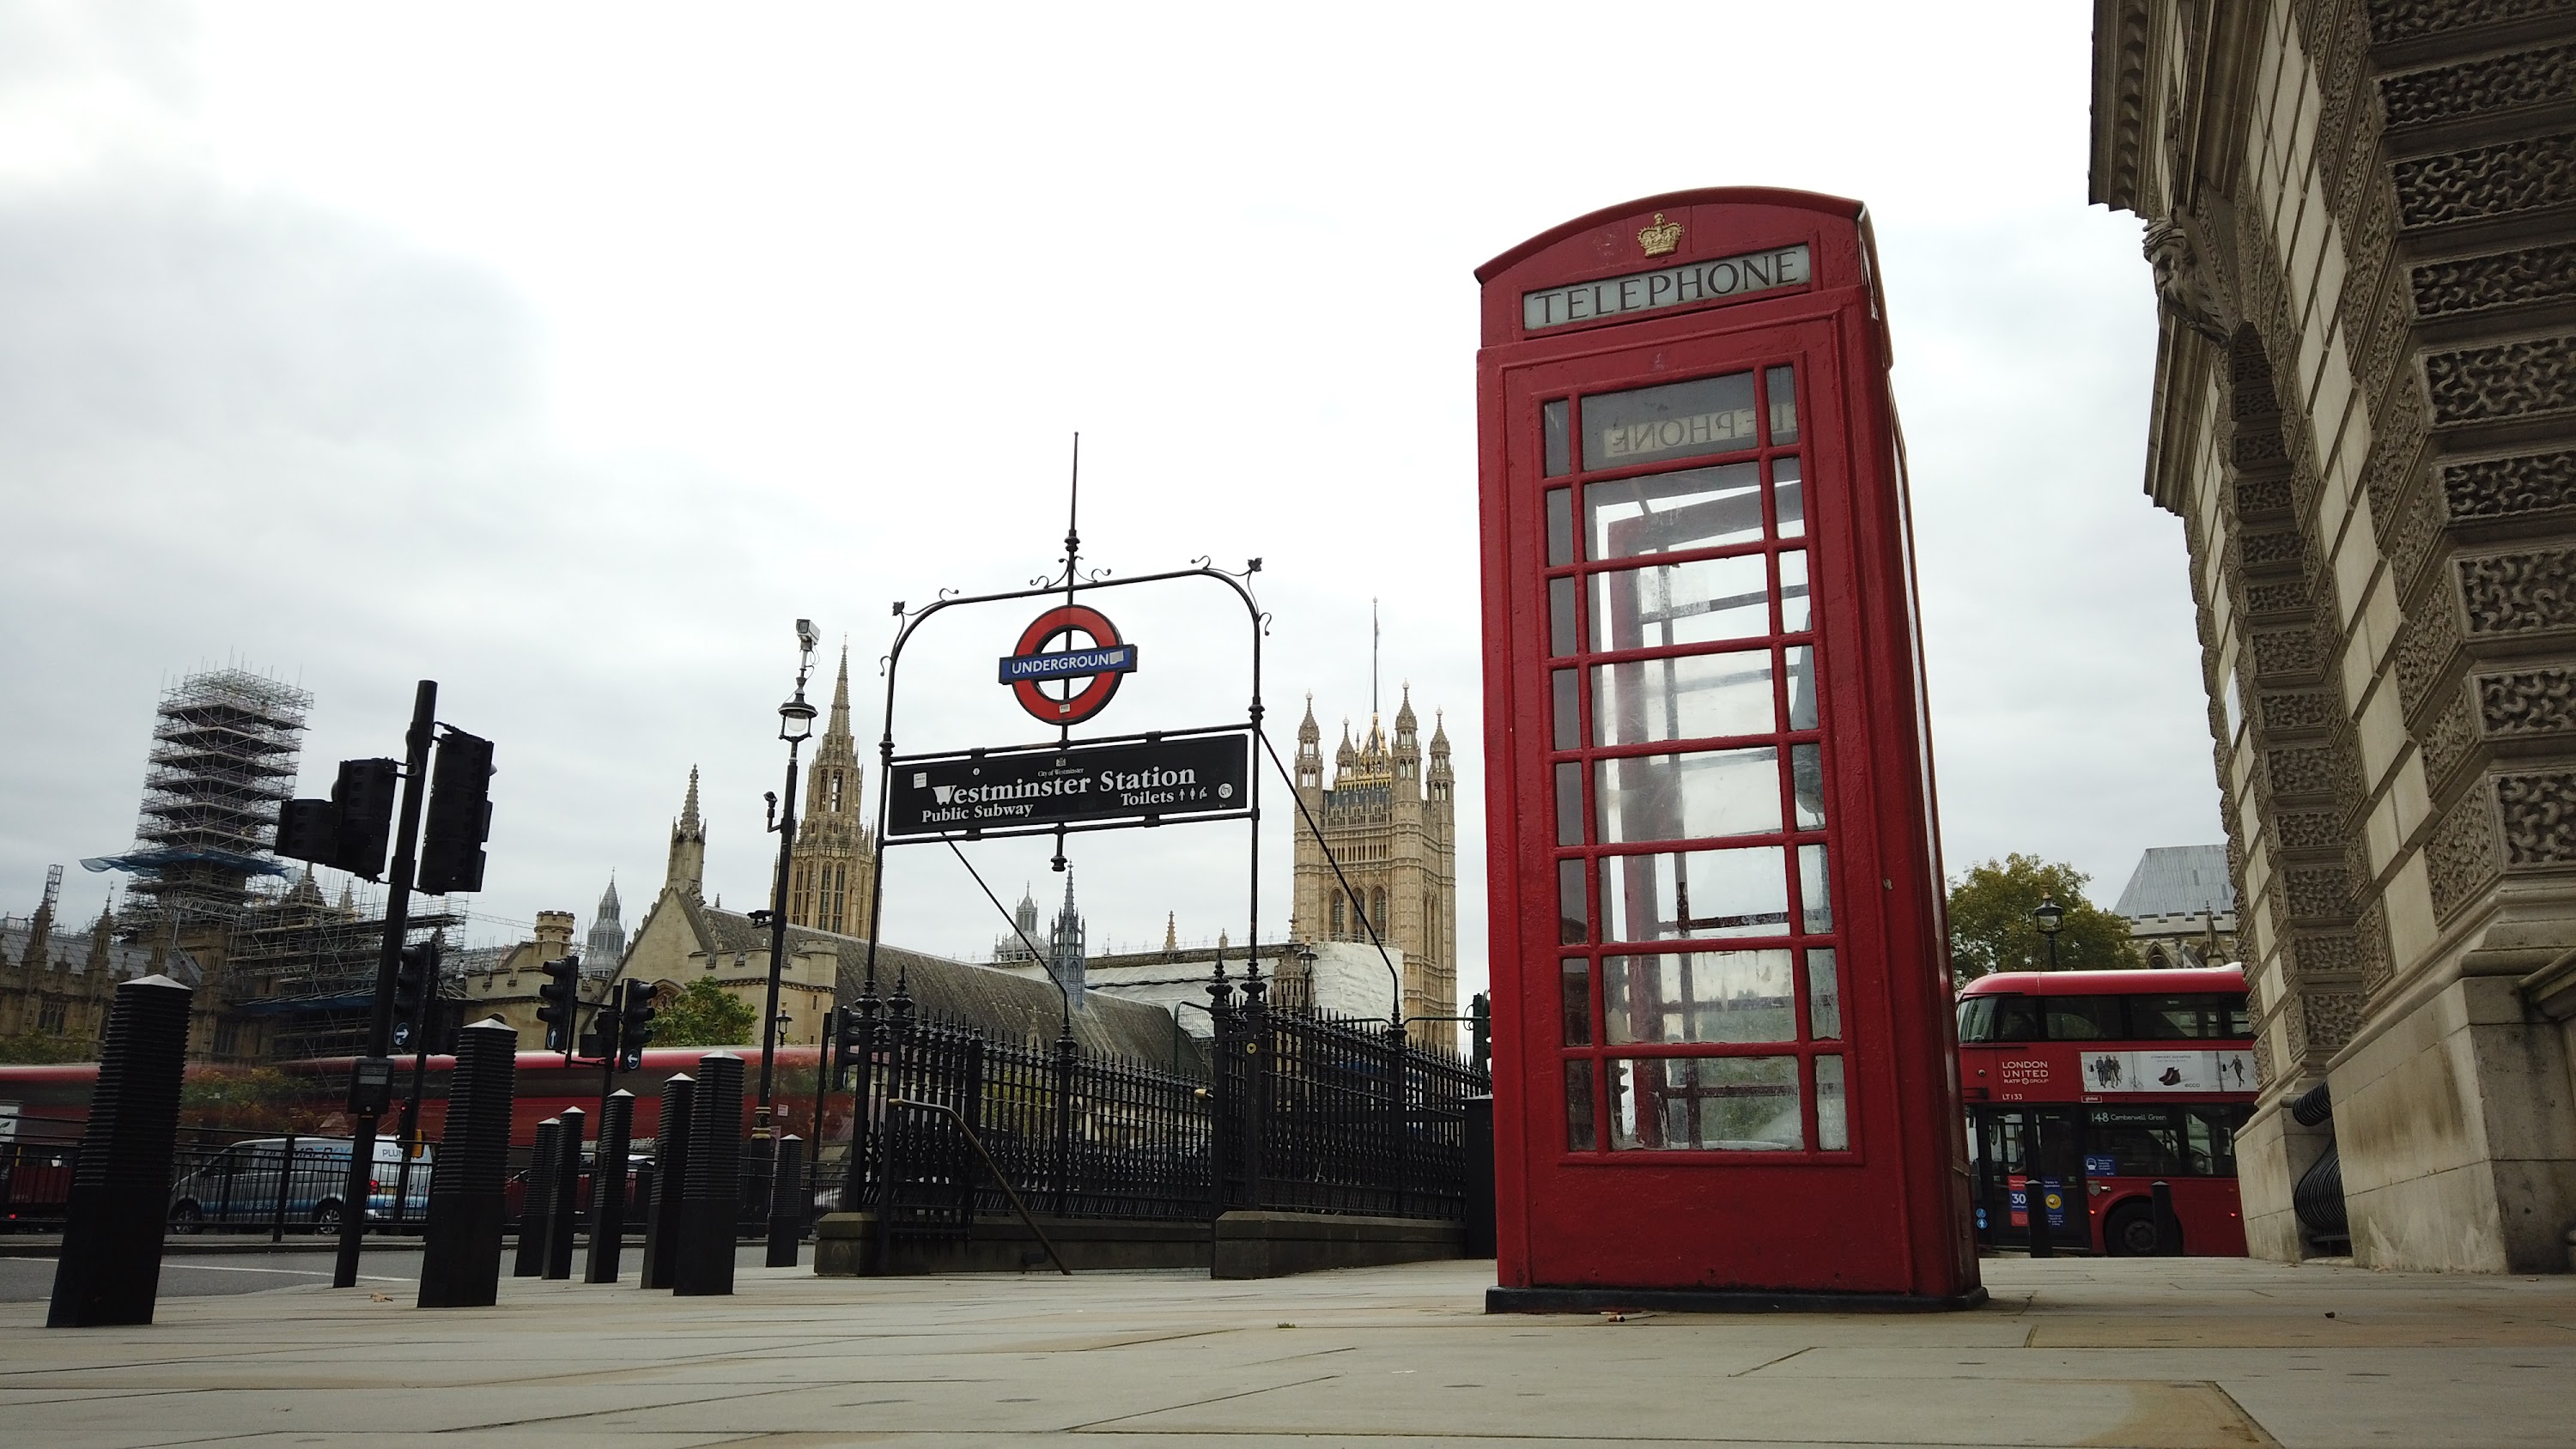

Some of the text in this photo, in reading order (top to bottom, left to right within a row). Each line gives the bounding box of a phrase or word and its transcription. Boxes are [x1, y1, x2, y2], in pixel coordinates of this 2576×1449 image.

[1534, 250, 1798, 324] TELEPHONE
[932, 777, 1091, 805] Westminster
[1100, 766, 1196, 792] Station
[1121, 790, 1175, 806] Toilets
[921, 803, 1034, 823] Public Subway
[2002, 1060, 2048, 1069] LONDON
[2002, 1070, 2049, 1078] UNITED
[2091, 1112, 2109, 1123] 148
[2148, 1113, 2166, 1121] Green
[2011, 1193, 2026, 1204] 30
